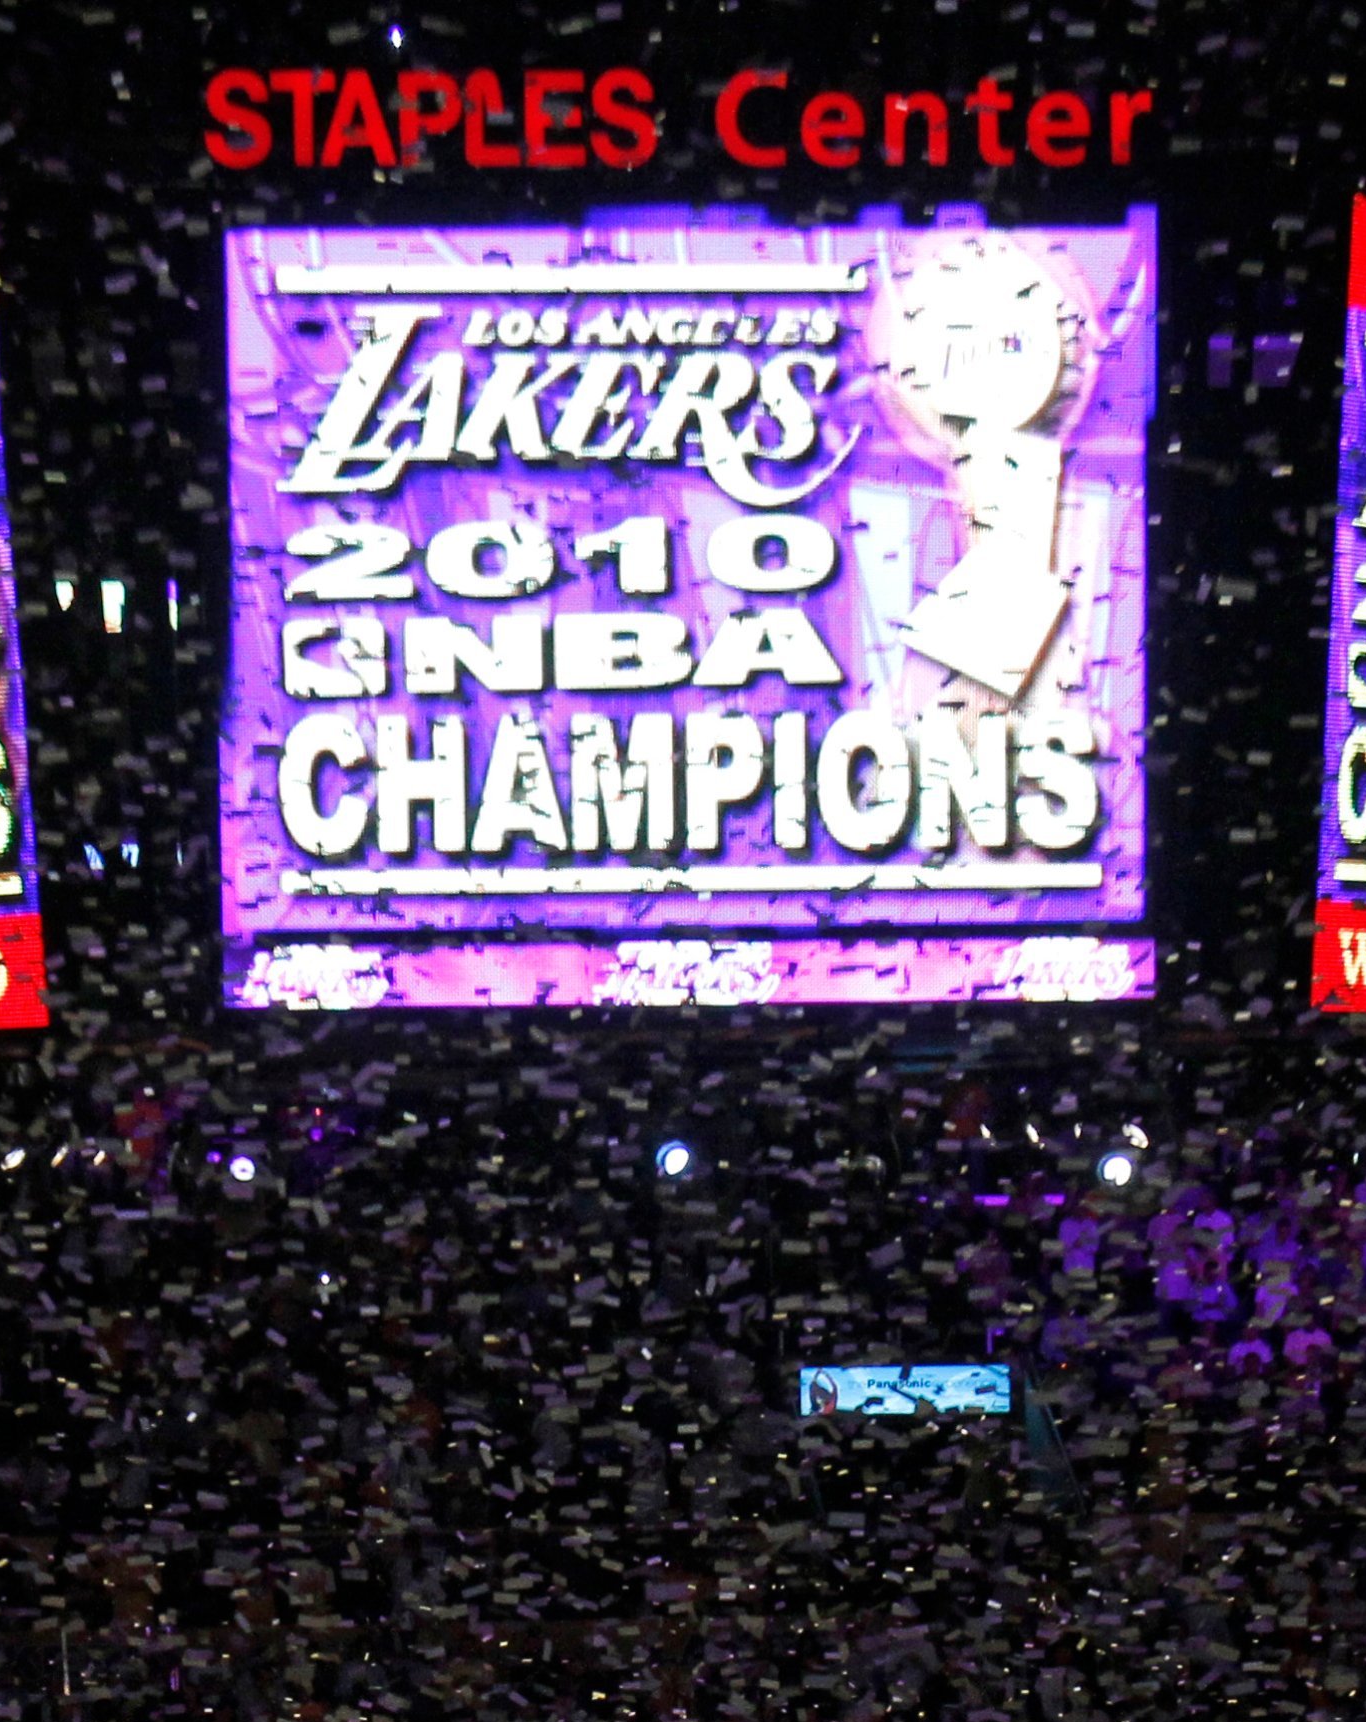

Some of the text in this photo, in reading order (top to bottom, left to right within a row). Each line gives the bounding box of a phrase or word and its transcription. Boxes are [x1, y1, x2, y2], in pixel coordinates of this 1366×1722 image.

[204, 68, 1153, 169] STAPLES Center
[464, 306, 839, 348] LOS ANGELES
[277, 304, 861, 507] LAKERS
[284, 515, 836, 600] 2010
[405, 608, 841, 694] NBA
[278, 710, 1097, 857] CHAMPIONS
